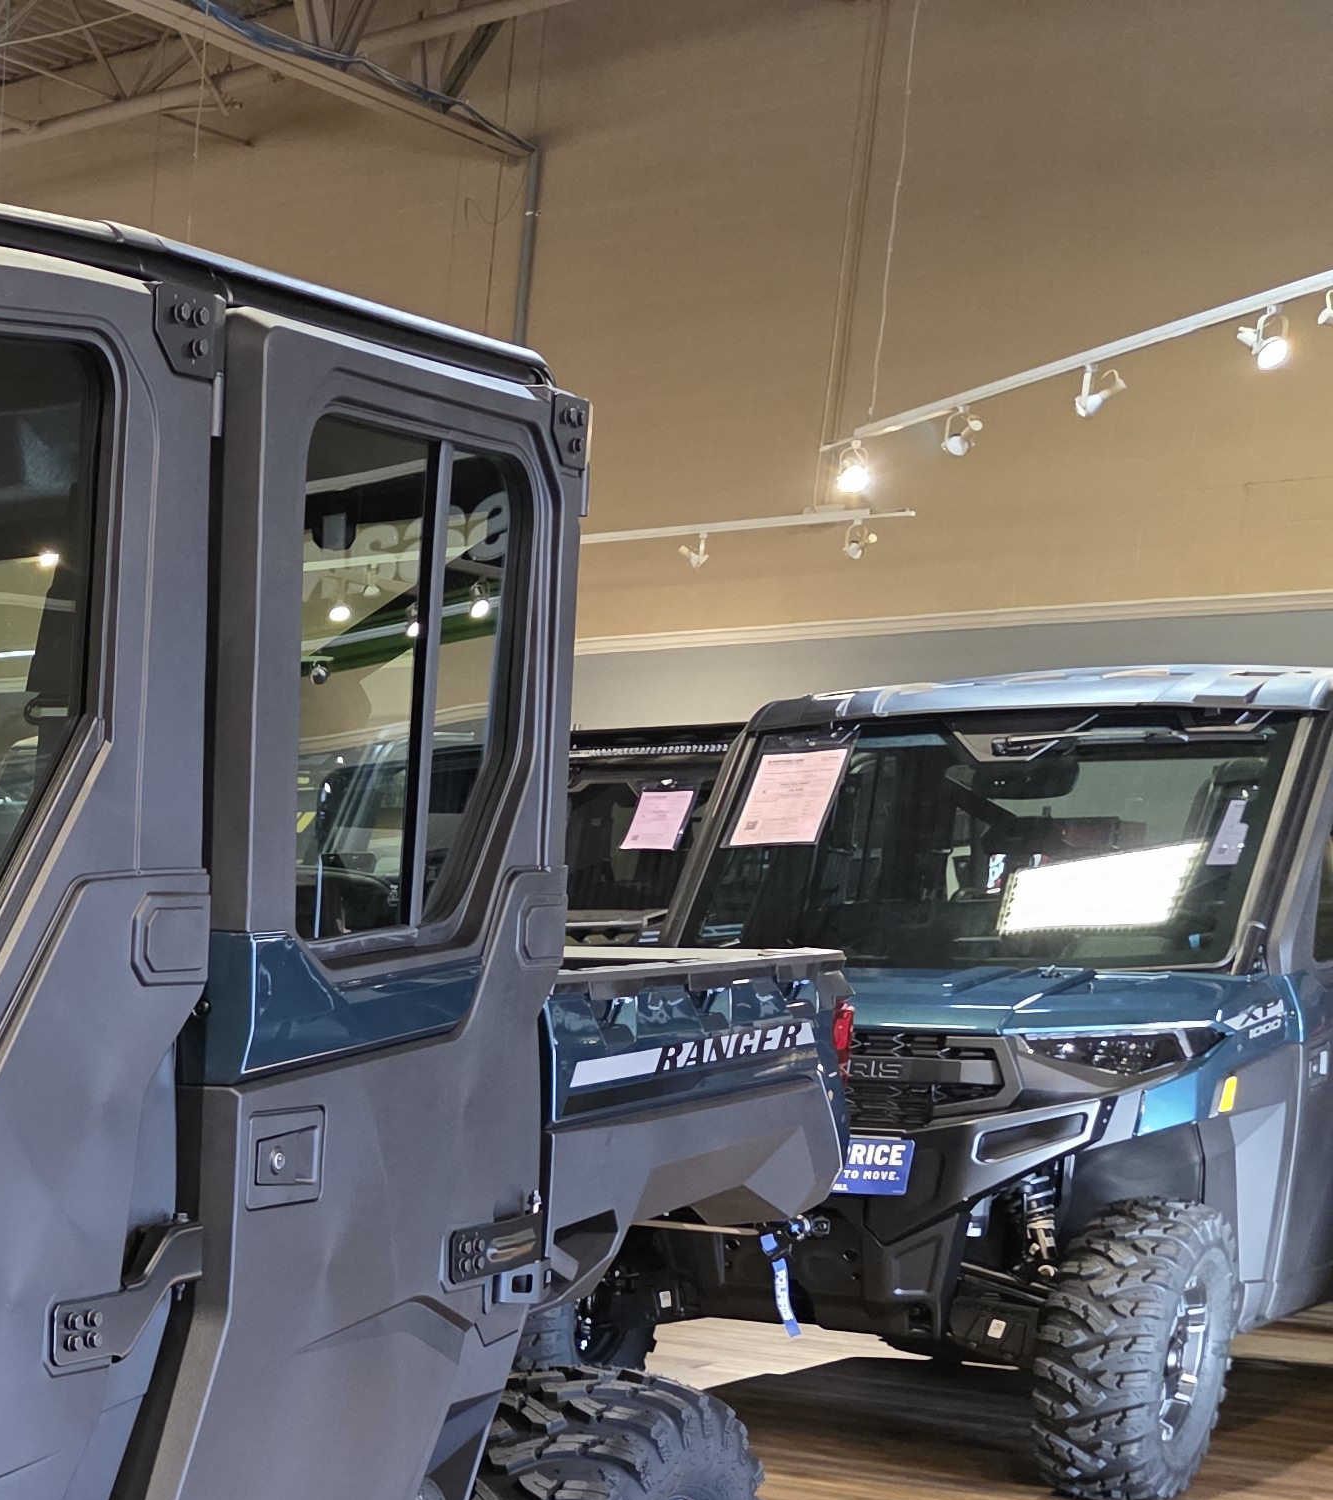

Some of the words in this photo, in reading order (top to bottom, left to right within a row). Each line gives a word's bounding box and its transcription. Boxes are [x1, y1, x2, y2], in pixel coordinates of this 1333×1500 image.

[1248, 1017, 1282, 1039] 1000
[653, 1020, 804, 1076] RANGER
[847, 1143, 907, 1166] RICE
[843, 1169, 860, 1180] TO
[862, 1170, 900, 1181] MOVE.
